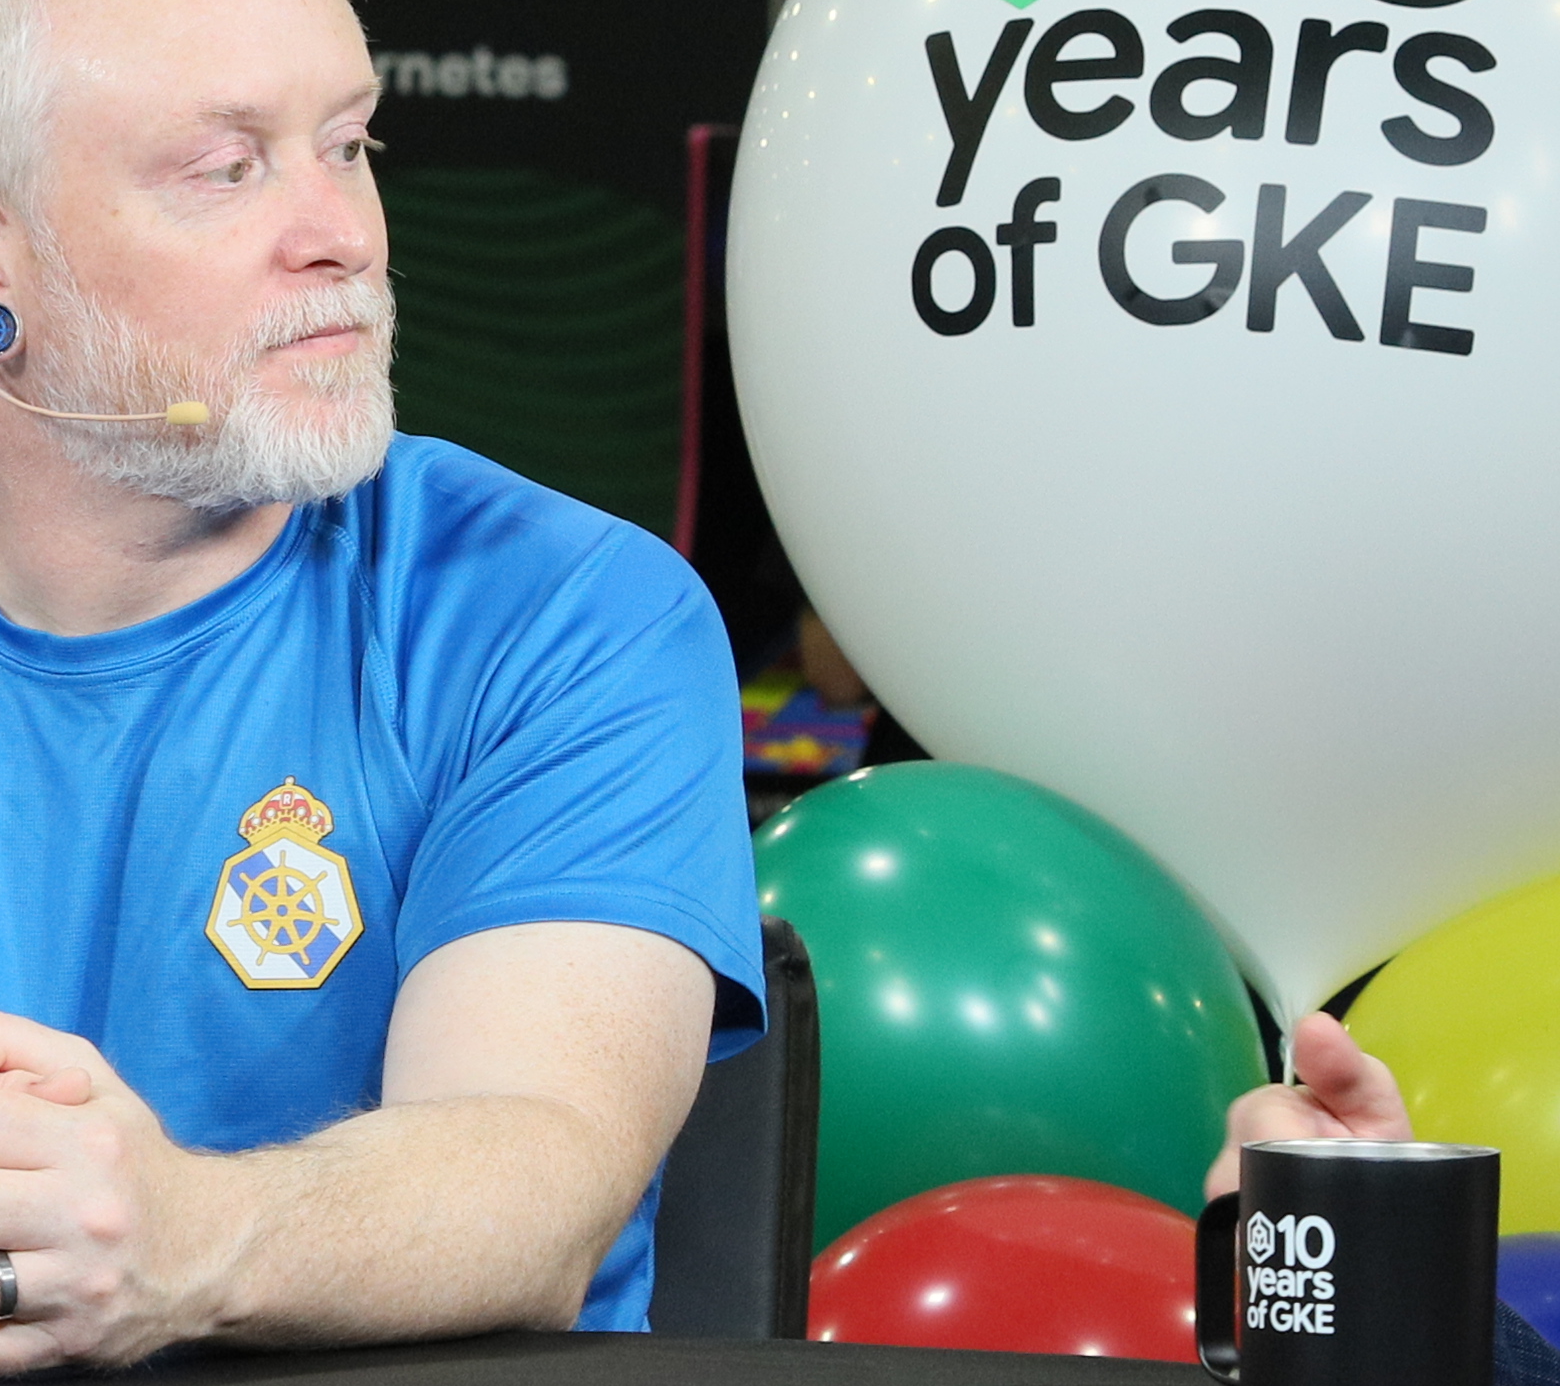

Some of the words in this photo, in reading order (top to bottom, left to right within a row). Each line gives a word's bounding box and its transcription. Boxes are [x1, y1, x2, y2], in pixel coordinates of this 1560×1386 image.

[925, 8, 1497, 207] years
[912, 177, 1061, 337] of
[1098, 173, 1488, 357] GKE
[1275, 1214, 1336, 1270] 10
[1247, 1265, 1336, 1301] years
[1247, 1299, 1269, 1330] of
[1269, 1300, 1336, 1335] GKE
